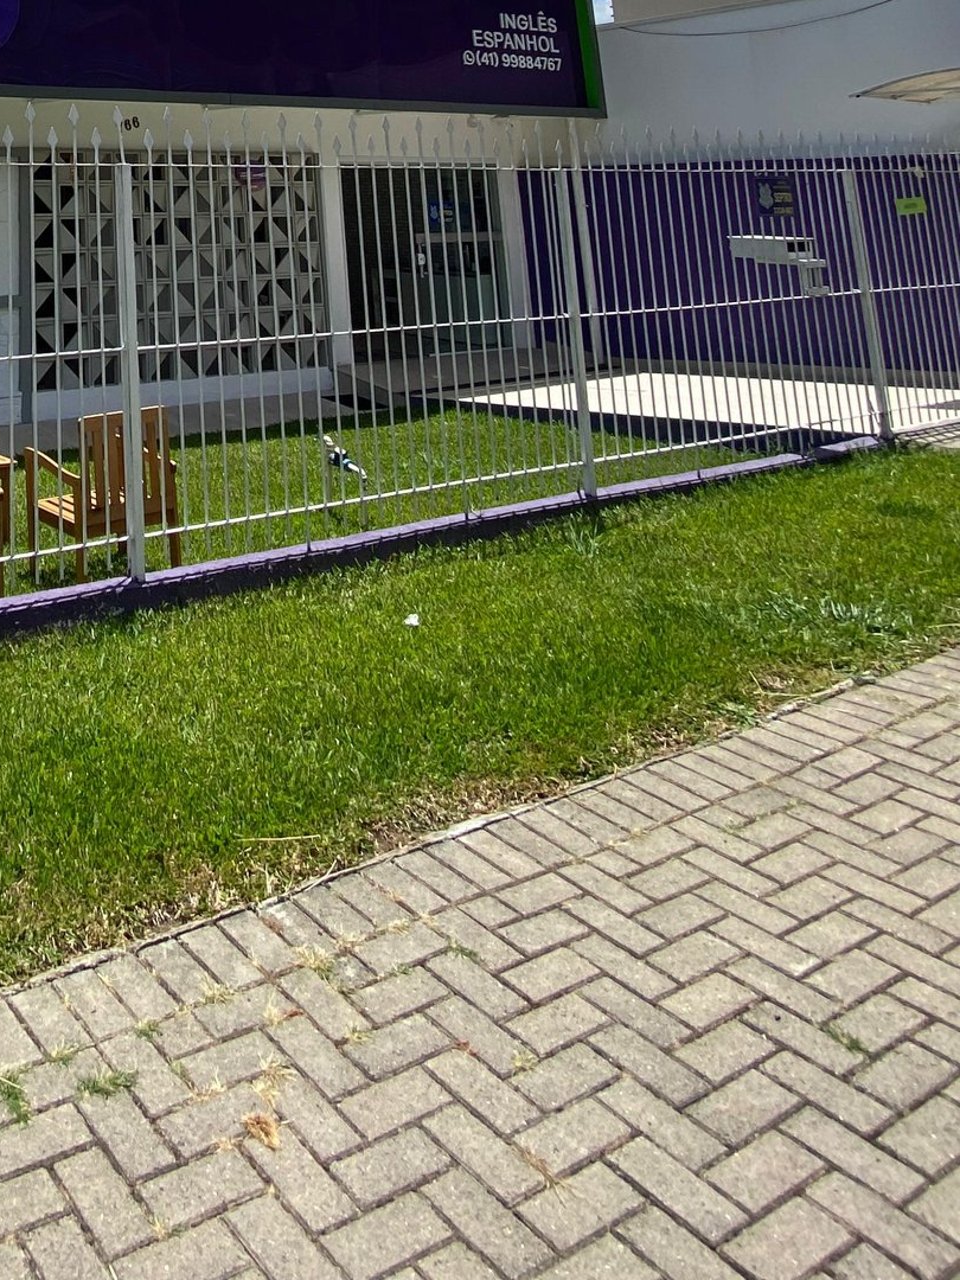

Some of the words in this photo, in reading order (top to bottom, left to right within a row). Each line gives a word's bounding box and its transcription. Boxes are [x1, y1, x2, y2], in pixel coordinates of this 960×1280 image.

[499, 10, 558, 33] INGLÊS
[472, 29, 560, 53] ESPANHOL
[476, 50, 499, 67] (41)
[501, 53, 562, 71] 99884767
